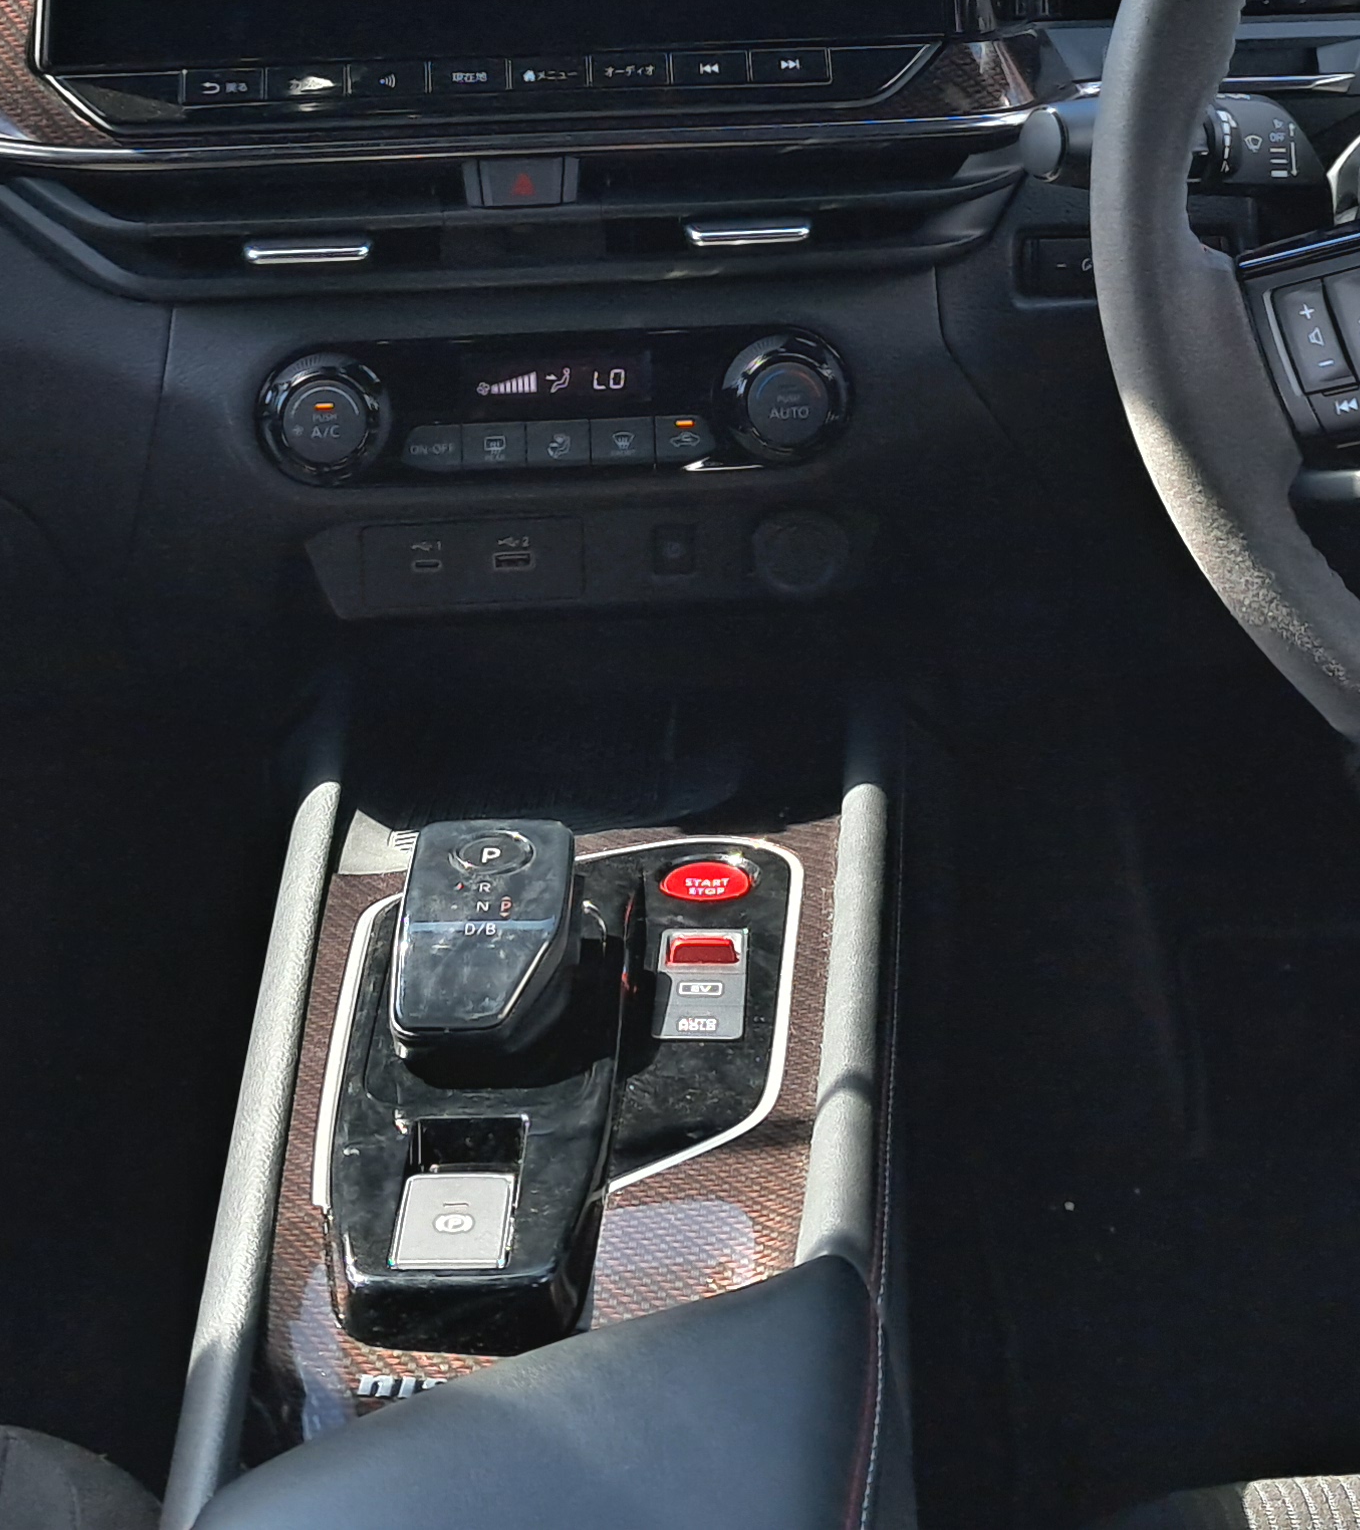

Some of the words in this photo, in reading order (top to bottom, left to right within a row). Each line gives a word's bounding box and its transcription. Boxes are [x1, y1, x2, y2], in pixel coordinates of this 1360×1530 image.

[452, 70, 488, 84] 現在地
[536, 68, 579, 82] メニュー
[604, 63, 655, 78] オーディオ
[1269, 132, 1286, 142] OFF
[312, 414, 337, 423] PUSH
[768, 406, 809, 420] AUTO
[310, 425, 340, 440] A/C
[481, 847, 501, 863] P
[479, 883, 491, 893] R
[685, 877, 730, 887] START
[688, 887, 725, 896] STOP
[476, 901, 490, 912] N
[464, 923, 496, 936] D/B
